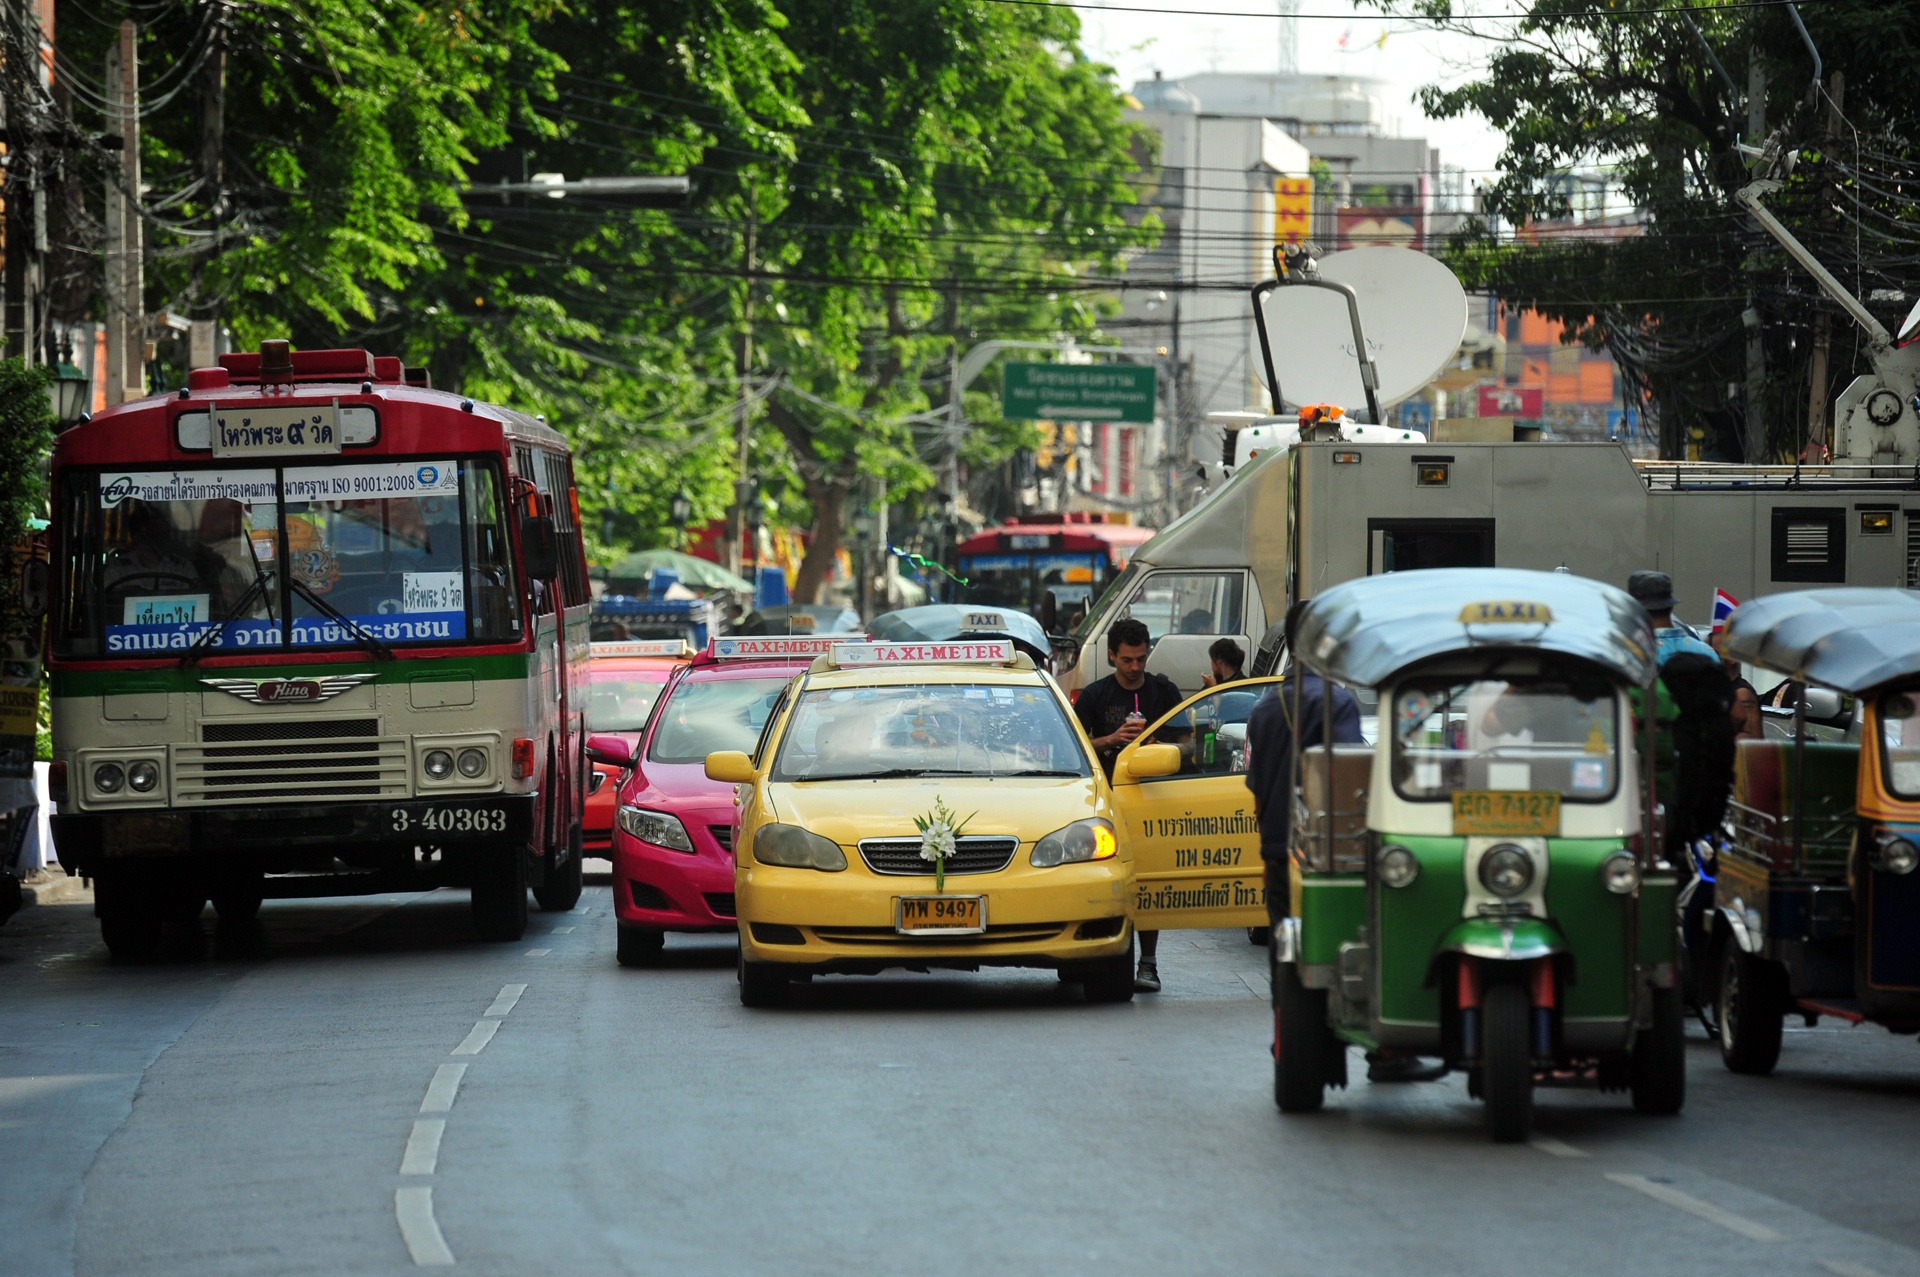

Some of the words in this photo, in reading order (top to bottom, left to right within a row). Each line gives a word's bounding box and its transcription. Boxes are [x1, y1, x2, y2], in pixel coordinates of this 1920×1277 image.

[217, 418, 284, 447] ไหว้พระ
[287, 419, 306, 445] ๙
[310, 415, 333, 444] วัด
[332, 477, 350, 494] ISO
[354, 475, 415, 493] 9001:2008
[441, 587, 447, 608] 9
[1479, 603, 1536, 618] TAXI
[969, 614, 998, 626] TAXI
[590, 644, 662, 654] AXI-METER
[737, 640, 844, 653] TAXI-METE
[873, 645, 1004, 661] TAXI-METER
[269, 683, 309, 699] Hino
[392, 808, 506, 831] 3-40363
[1202, 848, 1242, 866] 9497
[903, 901, 929, 918] ทพ
[935, 901, 977, 918] 9497
